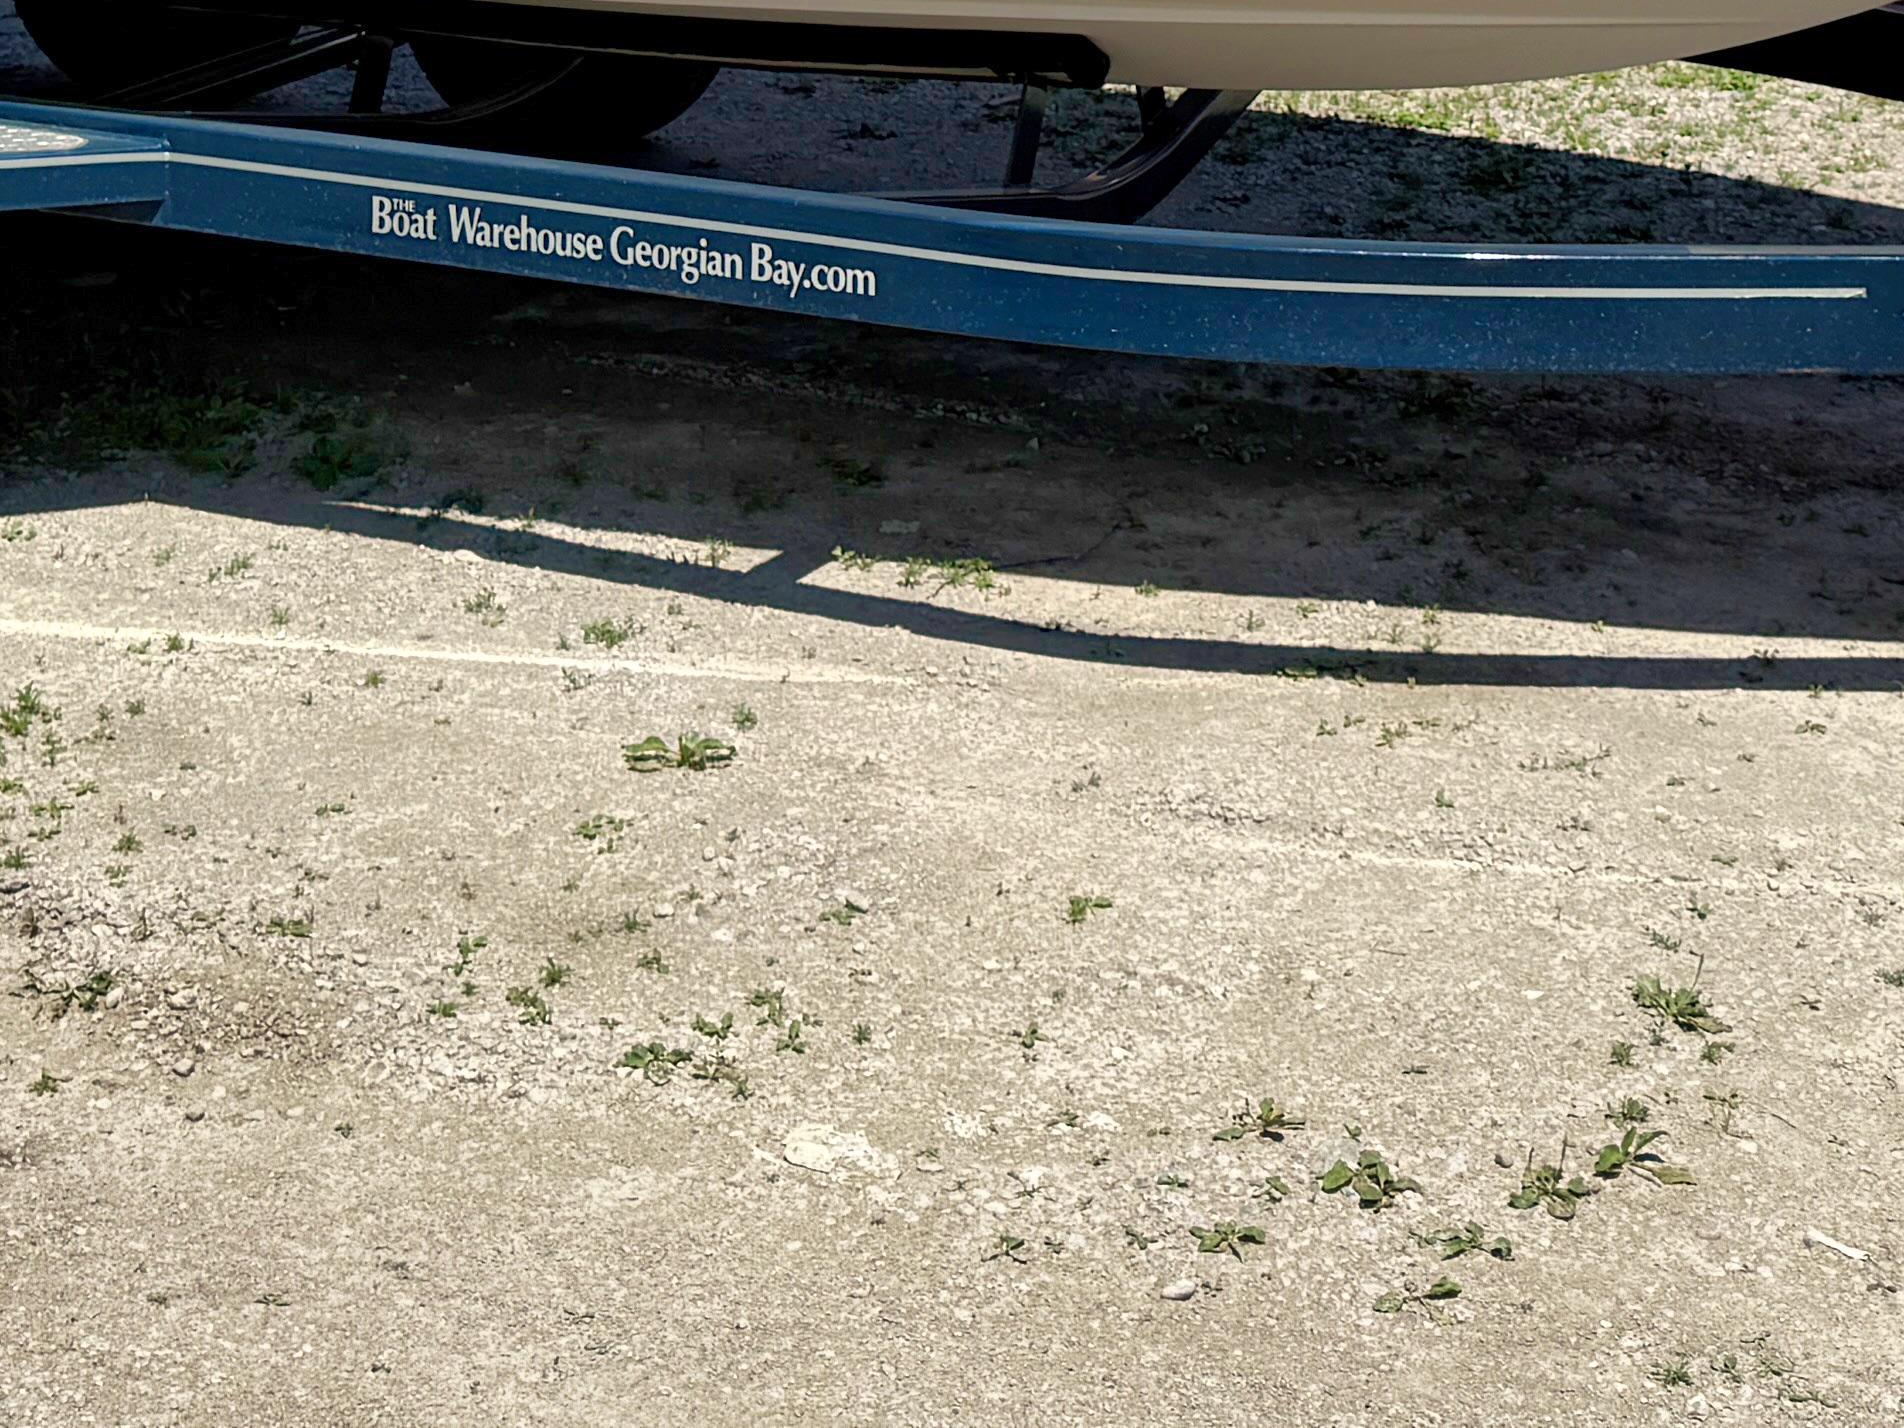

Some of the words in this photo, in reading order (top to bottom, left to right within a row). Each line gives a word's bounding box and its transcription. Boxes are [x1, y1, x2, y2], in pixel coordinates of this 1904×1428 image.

[391, 197, 417, 213] THE
[371, 195, 438, 241] Boat
[448, 203, 604, 261] Warehouse
[610, 226, 743, 285] Georgian
[750, 242, 877, 298] Bay.com
